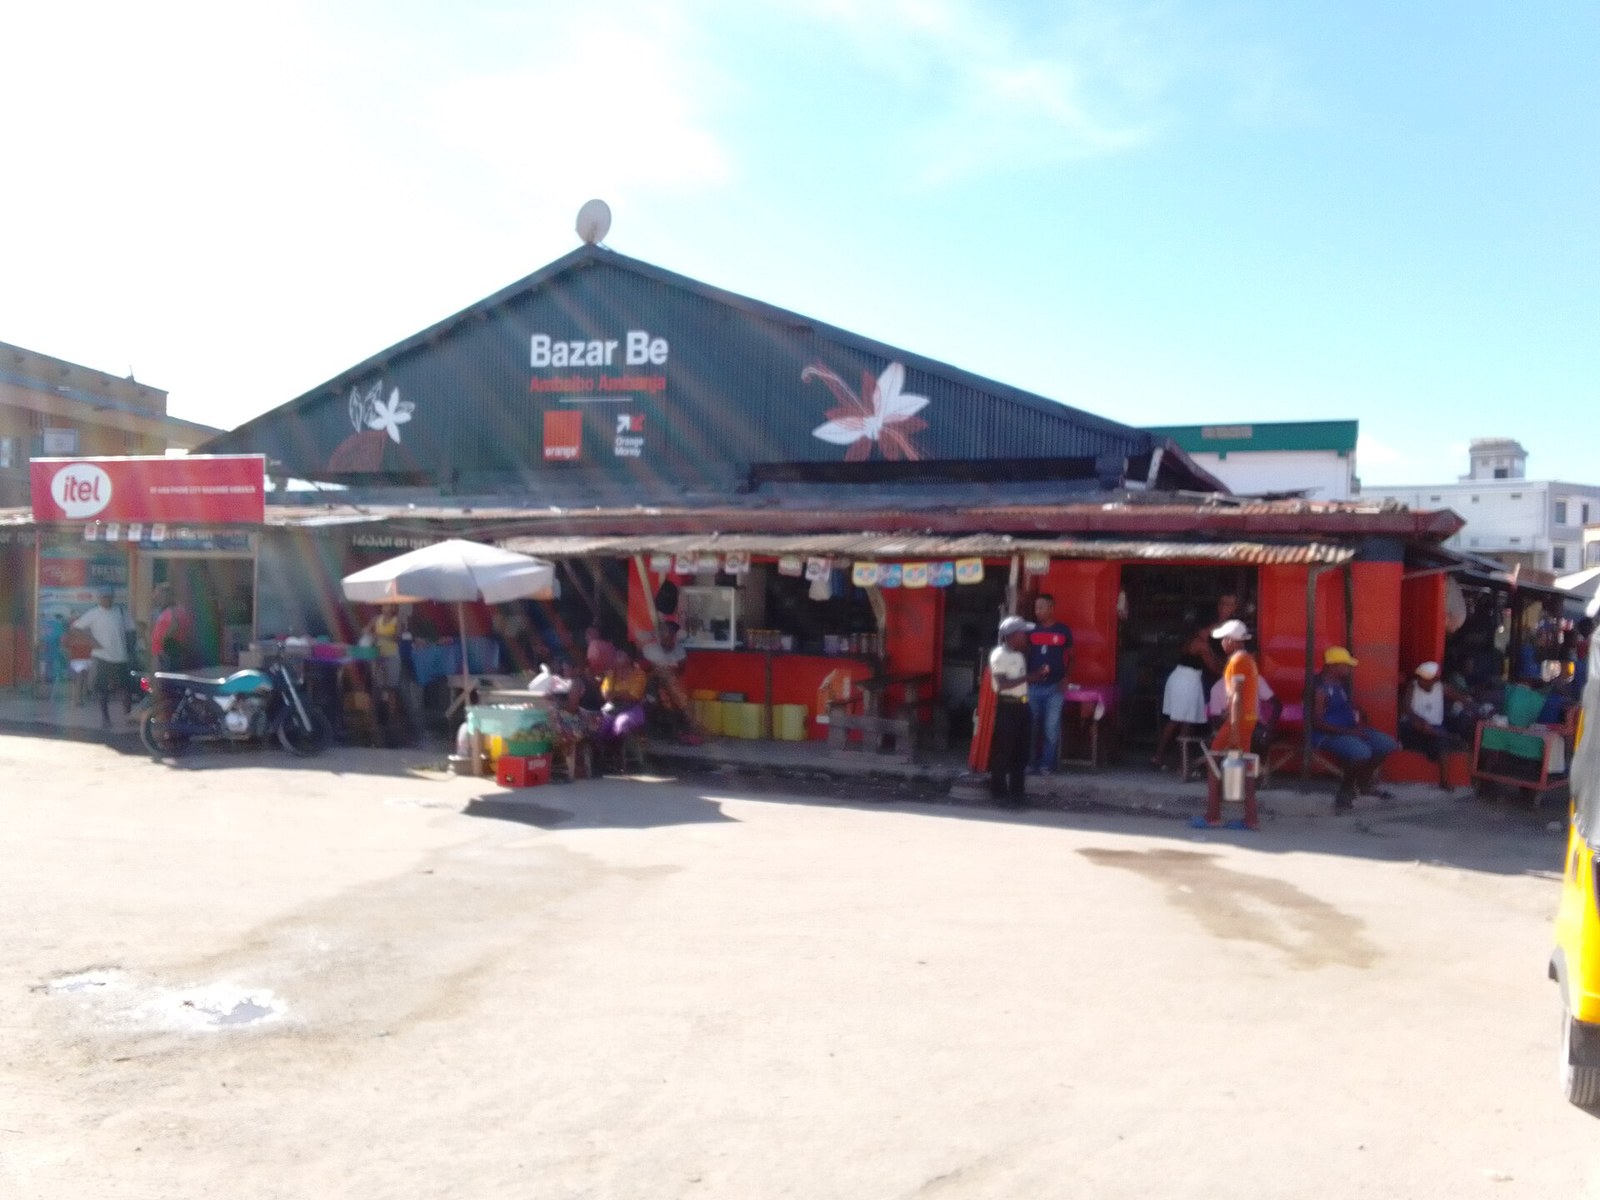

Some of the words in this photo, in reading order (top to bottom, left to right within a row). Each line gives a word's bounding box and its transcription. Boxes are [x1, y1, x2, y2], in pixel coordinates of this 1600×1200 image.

[530, 334, 618, 367] Bazar
[626, 331, 669, 365] Be
[545, 446, 577, 459] orange
[615, 437, 644, 449] Orange
[64, 475, 100, 502] itel
